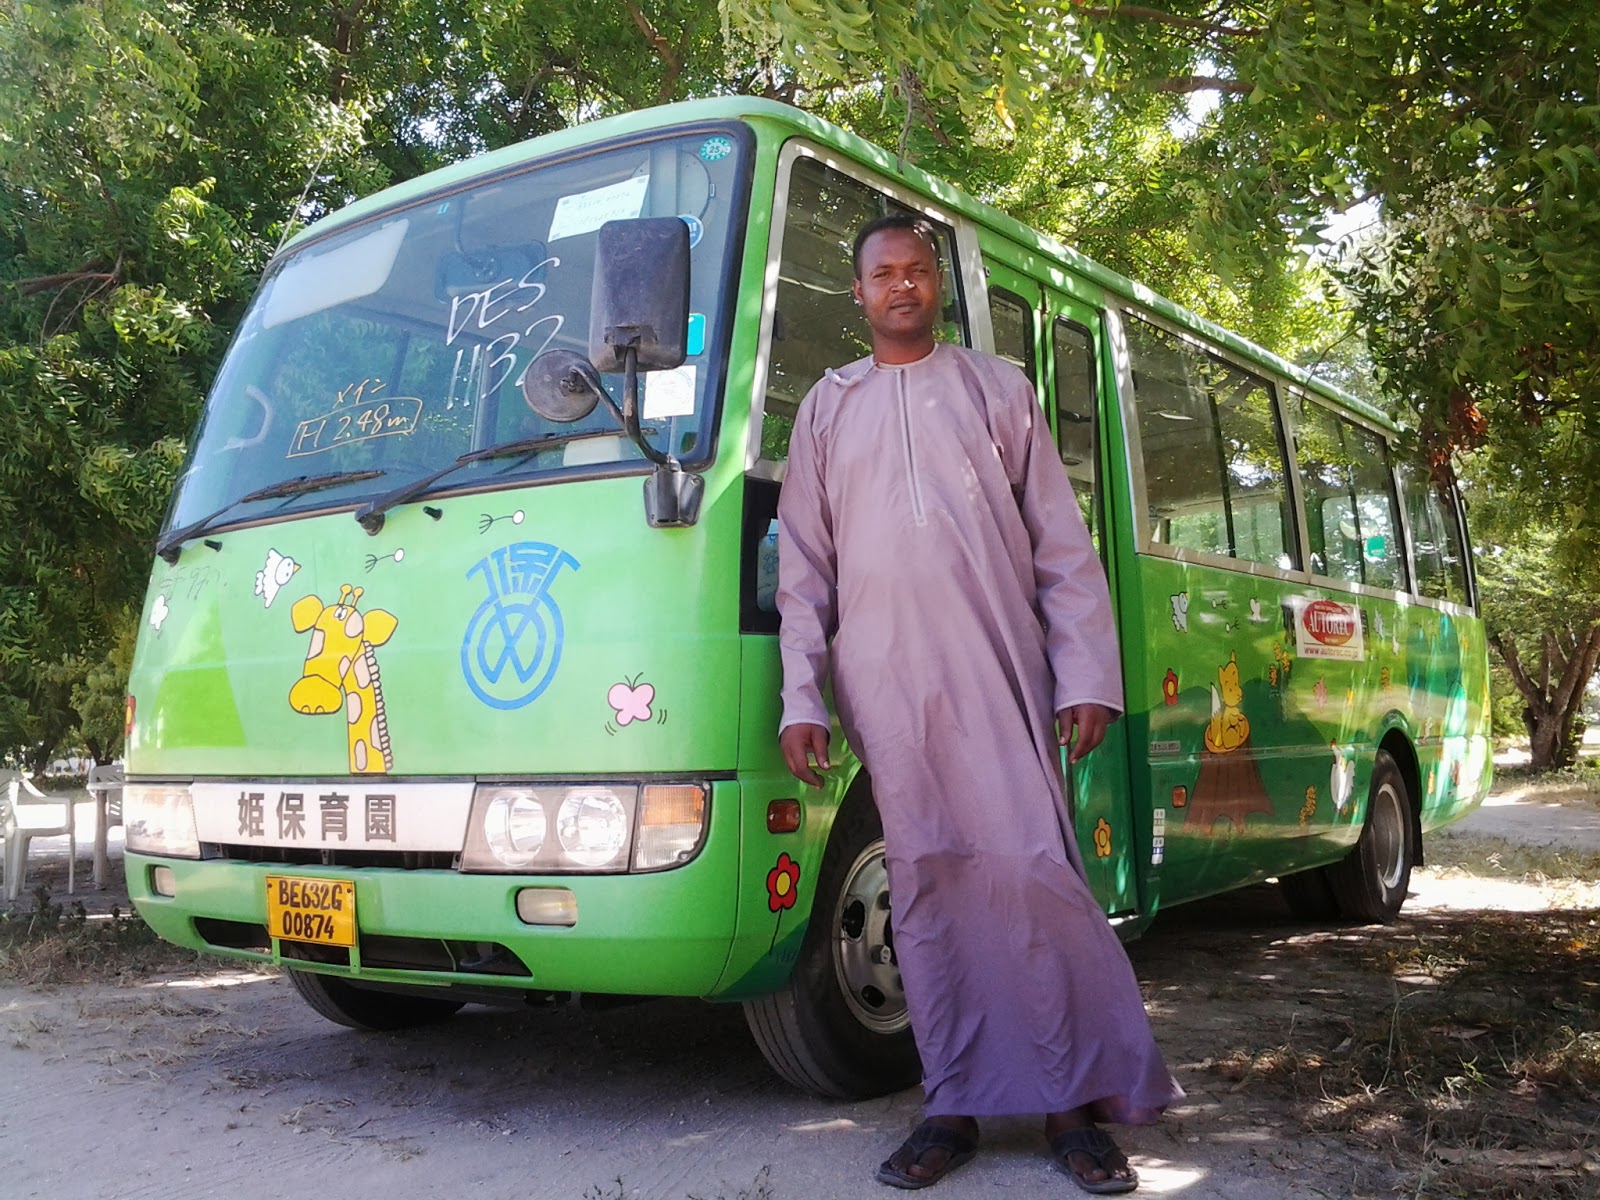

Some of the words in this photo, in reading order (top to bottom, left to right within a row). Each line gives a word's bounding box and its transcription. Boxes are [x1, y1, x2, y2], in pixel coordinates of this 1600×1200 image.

[708, 145, 721, 154] 25
[446, 256, 561, 346] DES
[446, 314, 565, 410] 1132
[1308, 610, 1352, 636] AUTOREC
[237, 791, 397, 842] 姫保育園
[278, 879, 343, 912] BE632G
[282, 910, 335, 939] 00874
